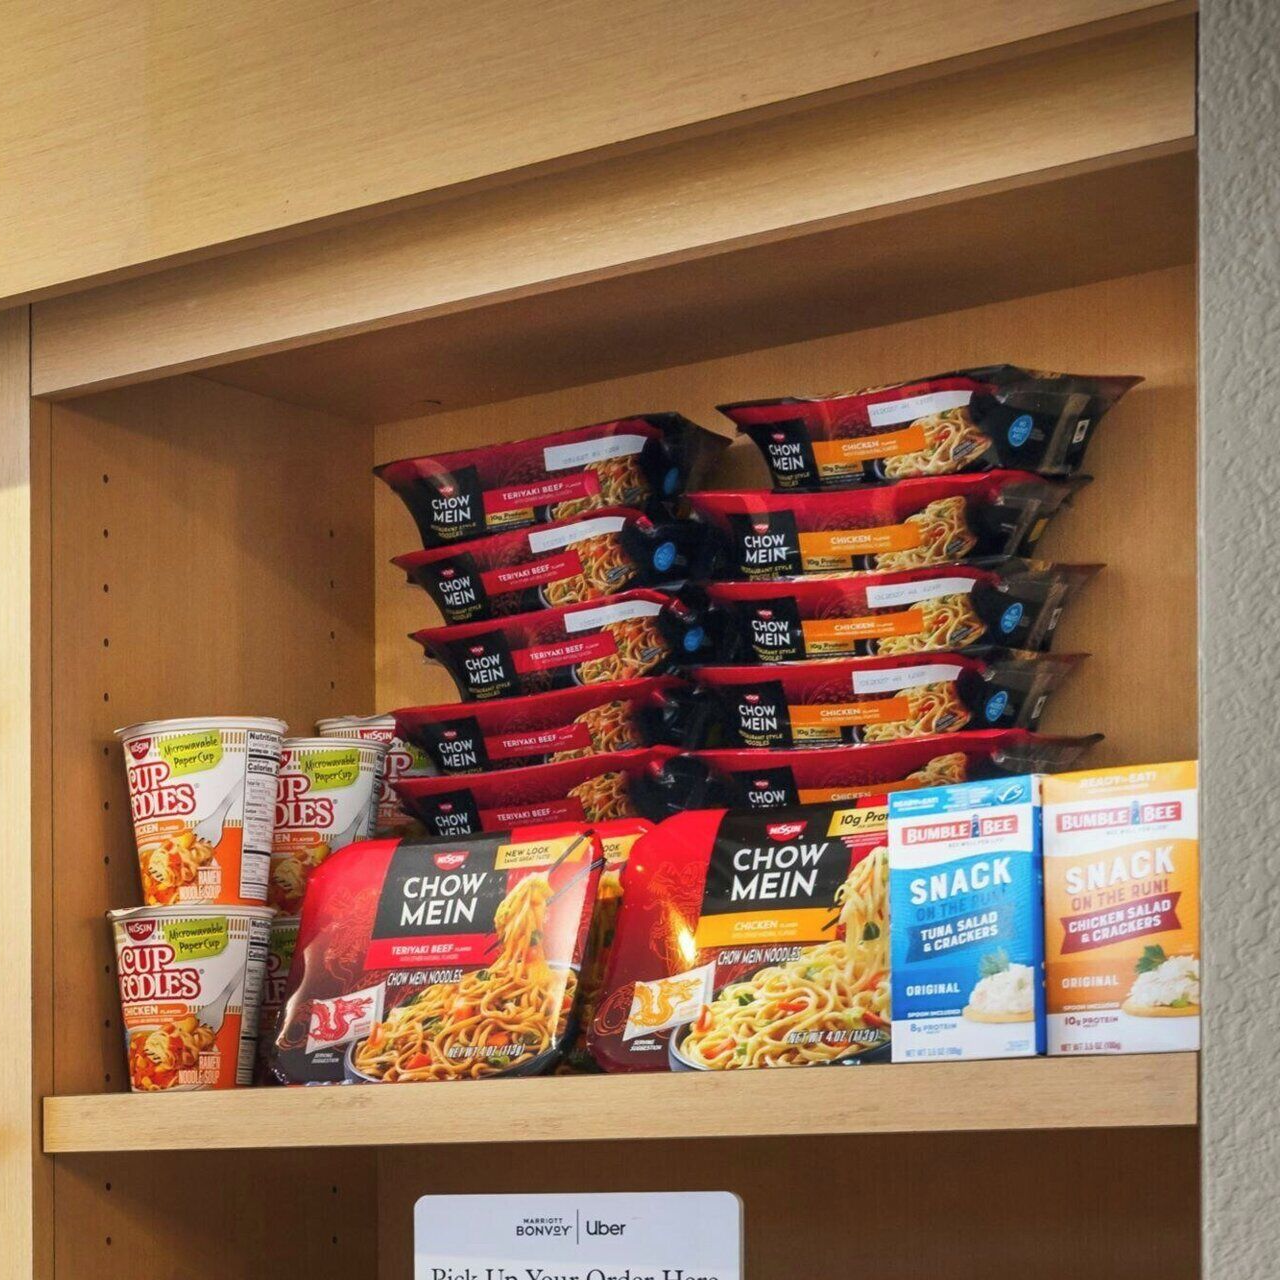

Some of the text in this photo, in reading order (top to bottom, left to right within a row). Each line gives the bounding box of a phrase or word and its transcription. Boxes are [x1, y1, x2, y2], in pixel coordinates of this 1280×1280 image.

[430, 494, 471, 511] CHOW
[433, 507, 472, 524] MEIN
[744, 533, 787, 550] CHOW
[745, 546, 788, 564] MEIN
[439, 576, 472, 594] CHOW
[362, 730, 393, 740] NISSIN
[164, 735, 219, 758] Microwavable
[304, 754, 356, 773] Microwavable
[1061, 803, 1178, 831] BUMBLE BEE
[769, 824, 803, 836] NISSIN
[906, 819, 1015, 844] BUMBLE BEE
[732, 842, 829, 871] CHOW
[1065, 845, 1176, 894] SNACK
[402, 873, 488, 899] CHOW
[730, 869, 819, 902] MEIN
[909, 856, 1014, 905] SNACK
[1070, 878, 1170, 912] ON THE RUN!
[399, 901, 479, 927] MEIN
[1068, 898, 1172, 934] CHICKEN SALAD
[127, 922, 153, 934] NISSIN
[168, 924, 224, 940] Microwavable
[920, 910, 999, 942] TUNA SALAD
[1081, 915, 1162, 944] & CRACKERS
[923, 924, 999, 953] & CRACKERS
[120, 946, 173, 974] CUP
[718, 946, 803, 965] CHOW MEIN NOODLES
[387, 968, 464, 986] CHOW MEIN NOODLES
[1061, 974, 1120, 990] ORIGINAL
[905, 982, 961, 997] ORIGINAL
[516, 1224, 570, 1237] BONVOY
[523, 1217, 564, 1225] MARRIOTT
[586, 1219, 627, 1237] Uber
